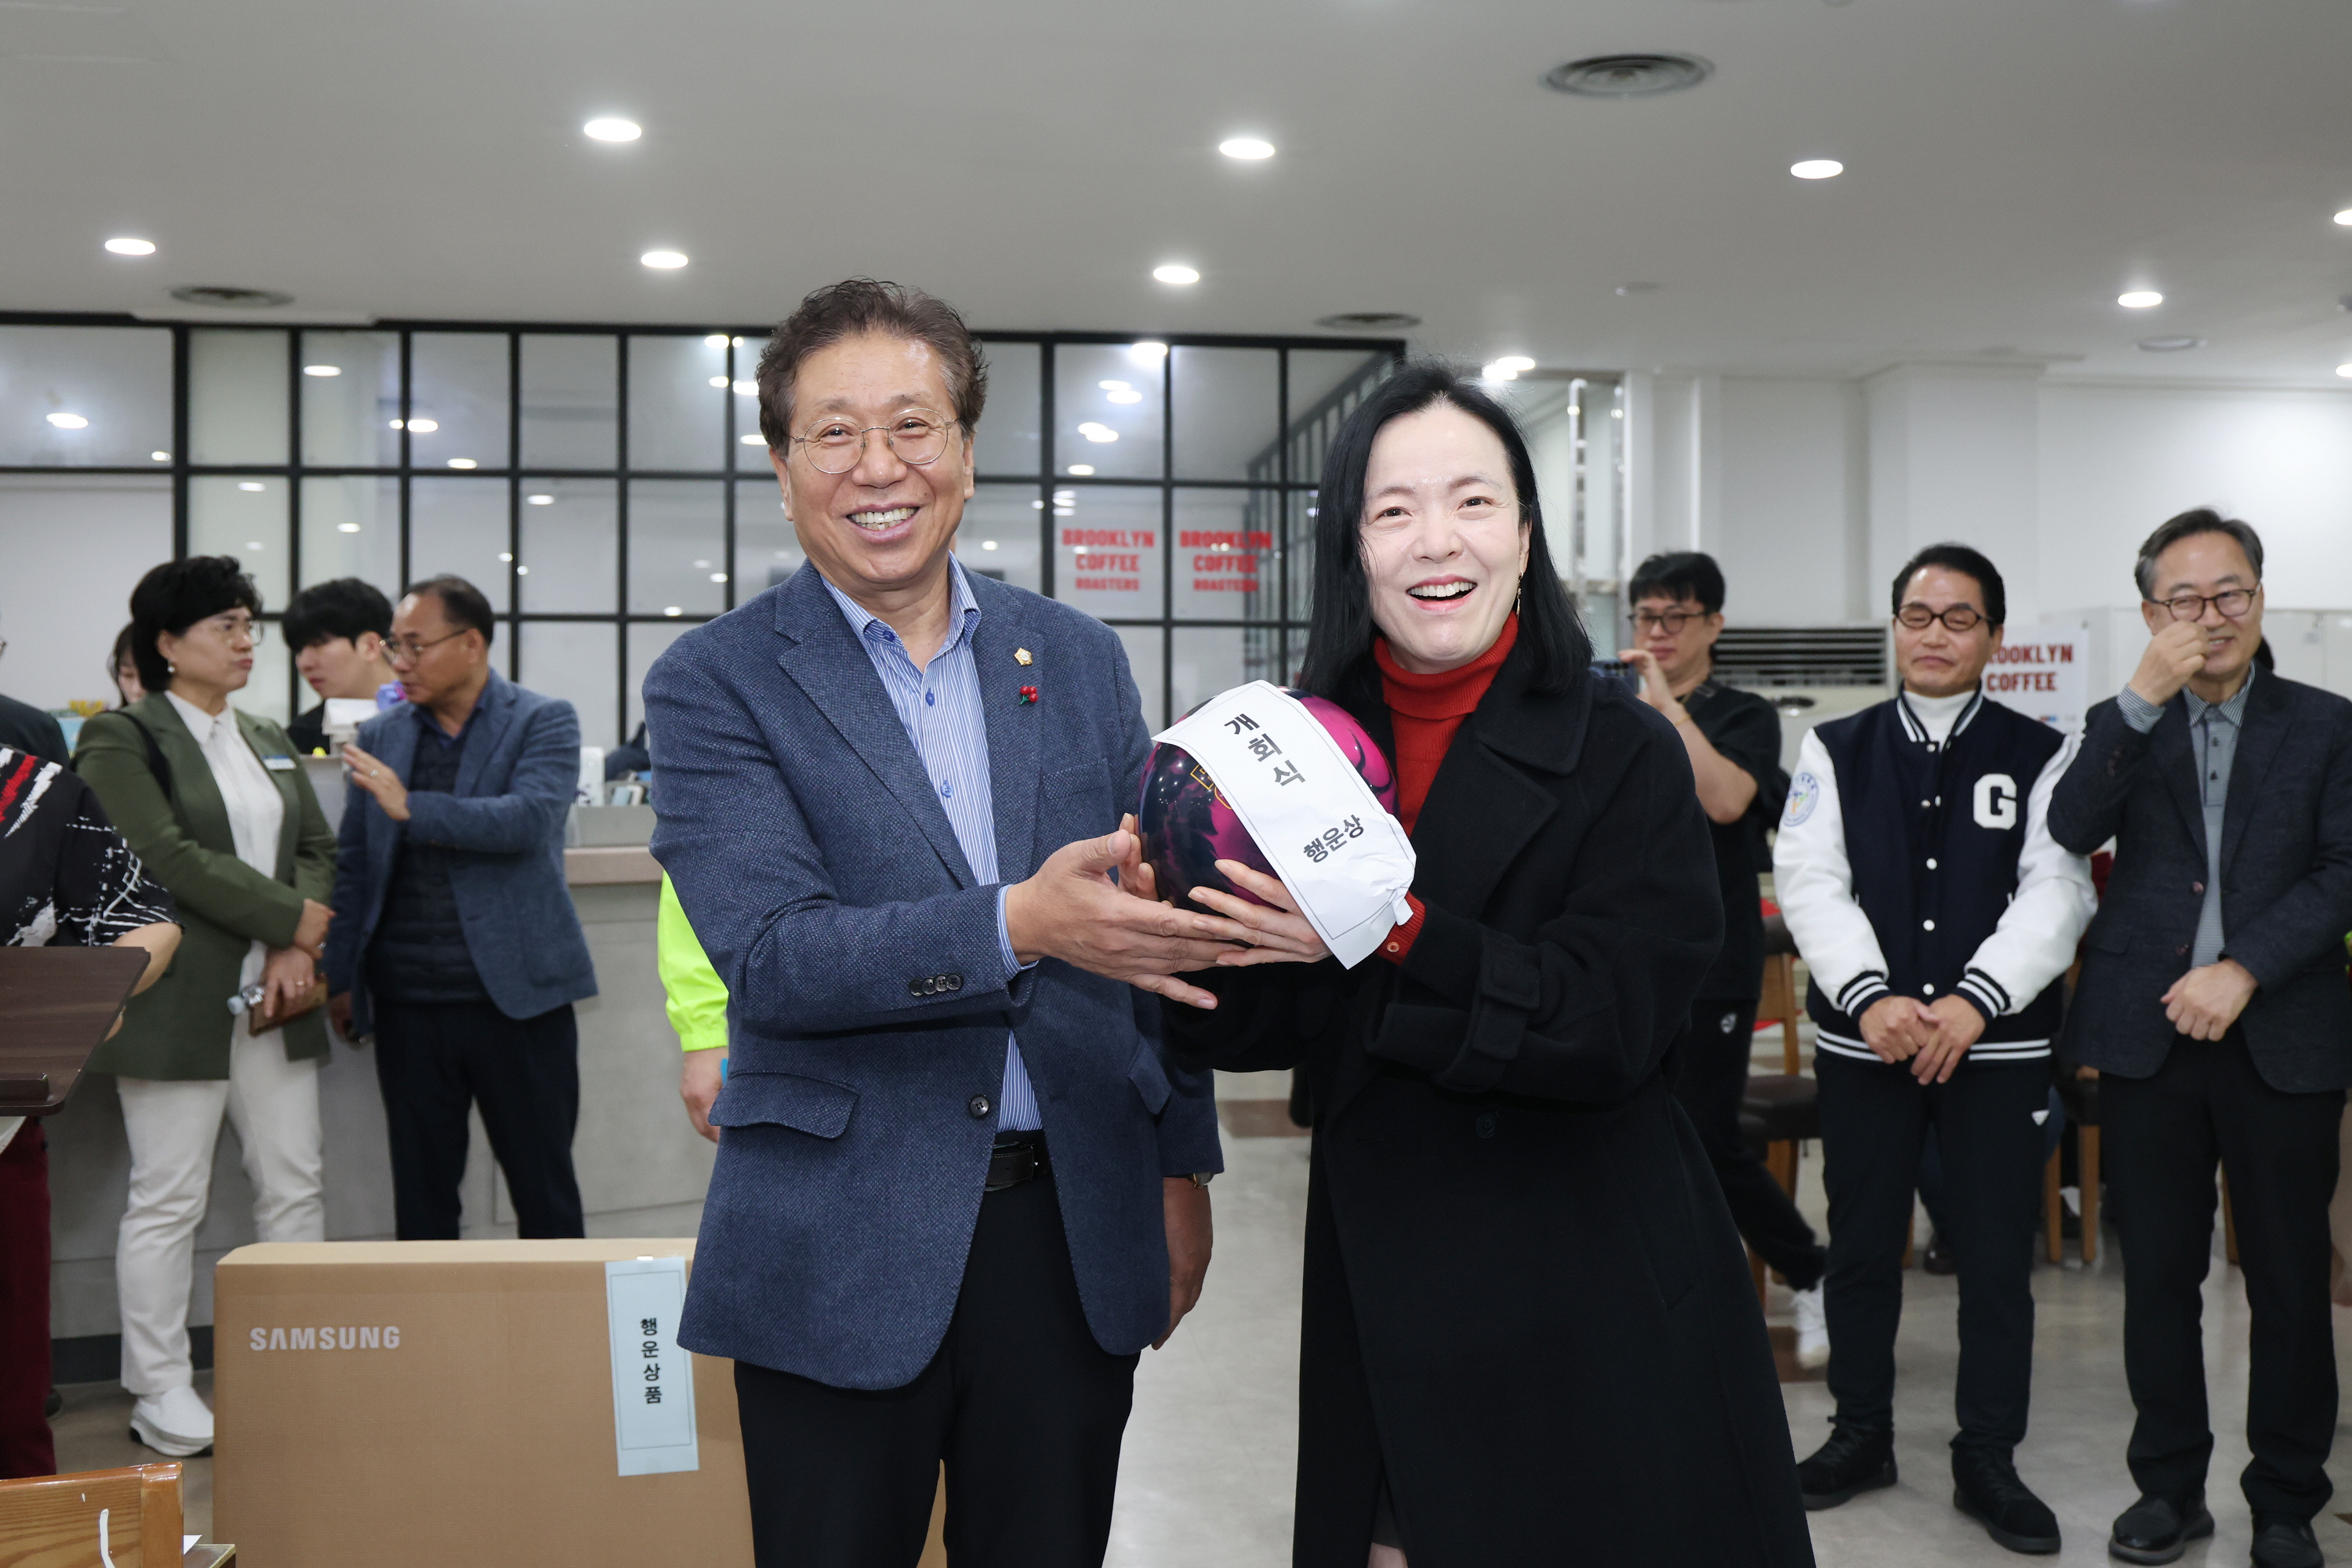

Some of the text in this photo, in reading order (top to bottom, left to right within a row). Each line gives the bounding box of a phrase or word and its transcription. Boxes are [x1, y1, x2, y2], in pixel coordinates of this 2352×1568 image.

[1062, 529, 1154, 547] BROOKLYN
[1180, 530, 1272, 548] BROOKLYN
[1076, 554, 1140, 572] COFFEE
[1194, 554, 1258, 572] COFFEE
[1987, 644, 2073, 665] OOKLYN
[1987, 672, 2057, 691] COFFEE
[1224, 713, 1305, 786] 개회식
[1973, 773, 2017, 830] G
[1303, 815, 1364, 862] 행운상
[249, 1326, 401, 1351] SAMSUNG
[640, 1317, 662, 1405] 행운상품
